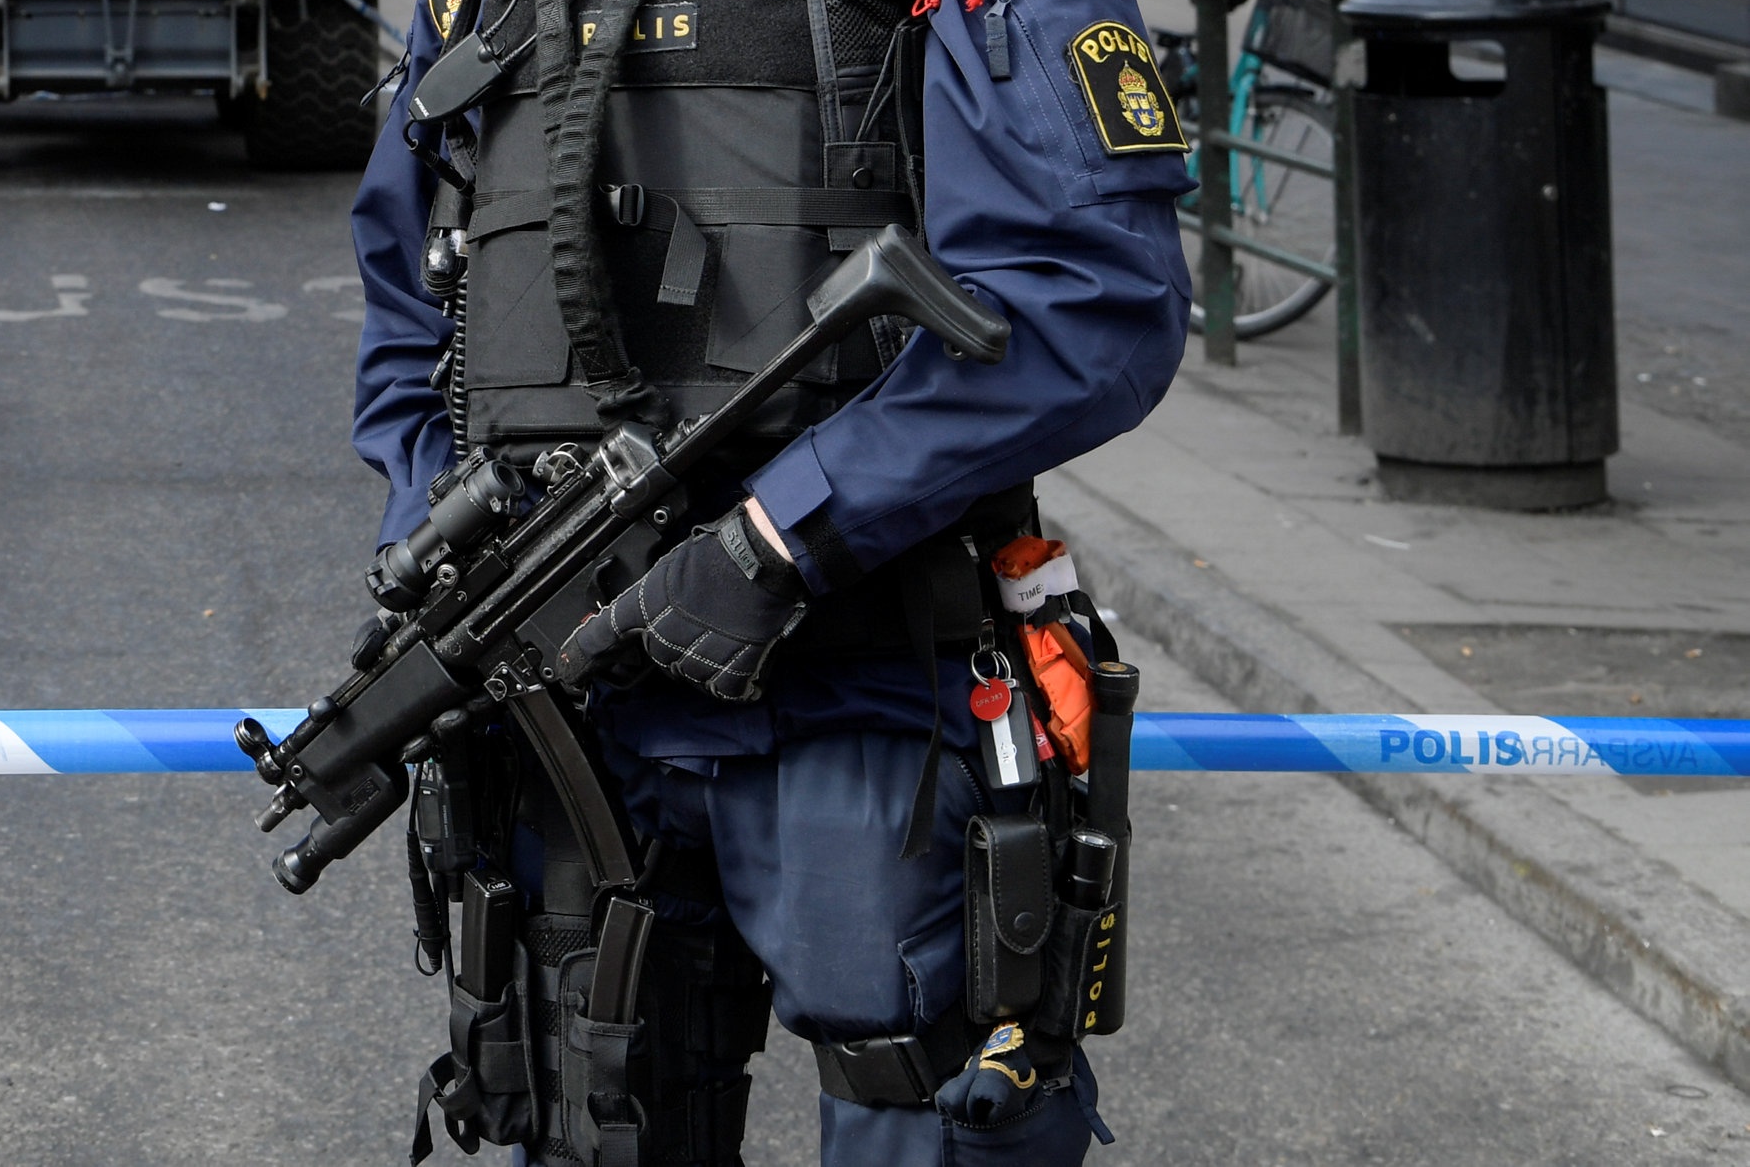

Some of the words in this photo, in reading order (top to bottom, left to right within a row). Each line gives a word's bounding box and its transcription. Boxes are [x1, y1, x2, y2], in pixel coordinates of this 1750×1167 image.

[582, 14, 690, 46] PLIS
[1080, 30, 1148, 63] POLIS
[1018, 583, 1044, 602] TIME:
[1380, 730, 1523, 766] POLIS
[1085, 913, 1116, 1029] POLIS
